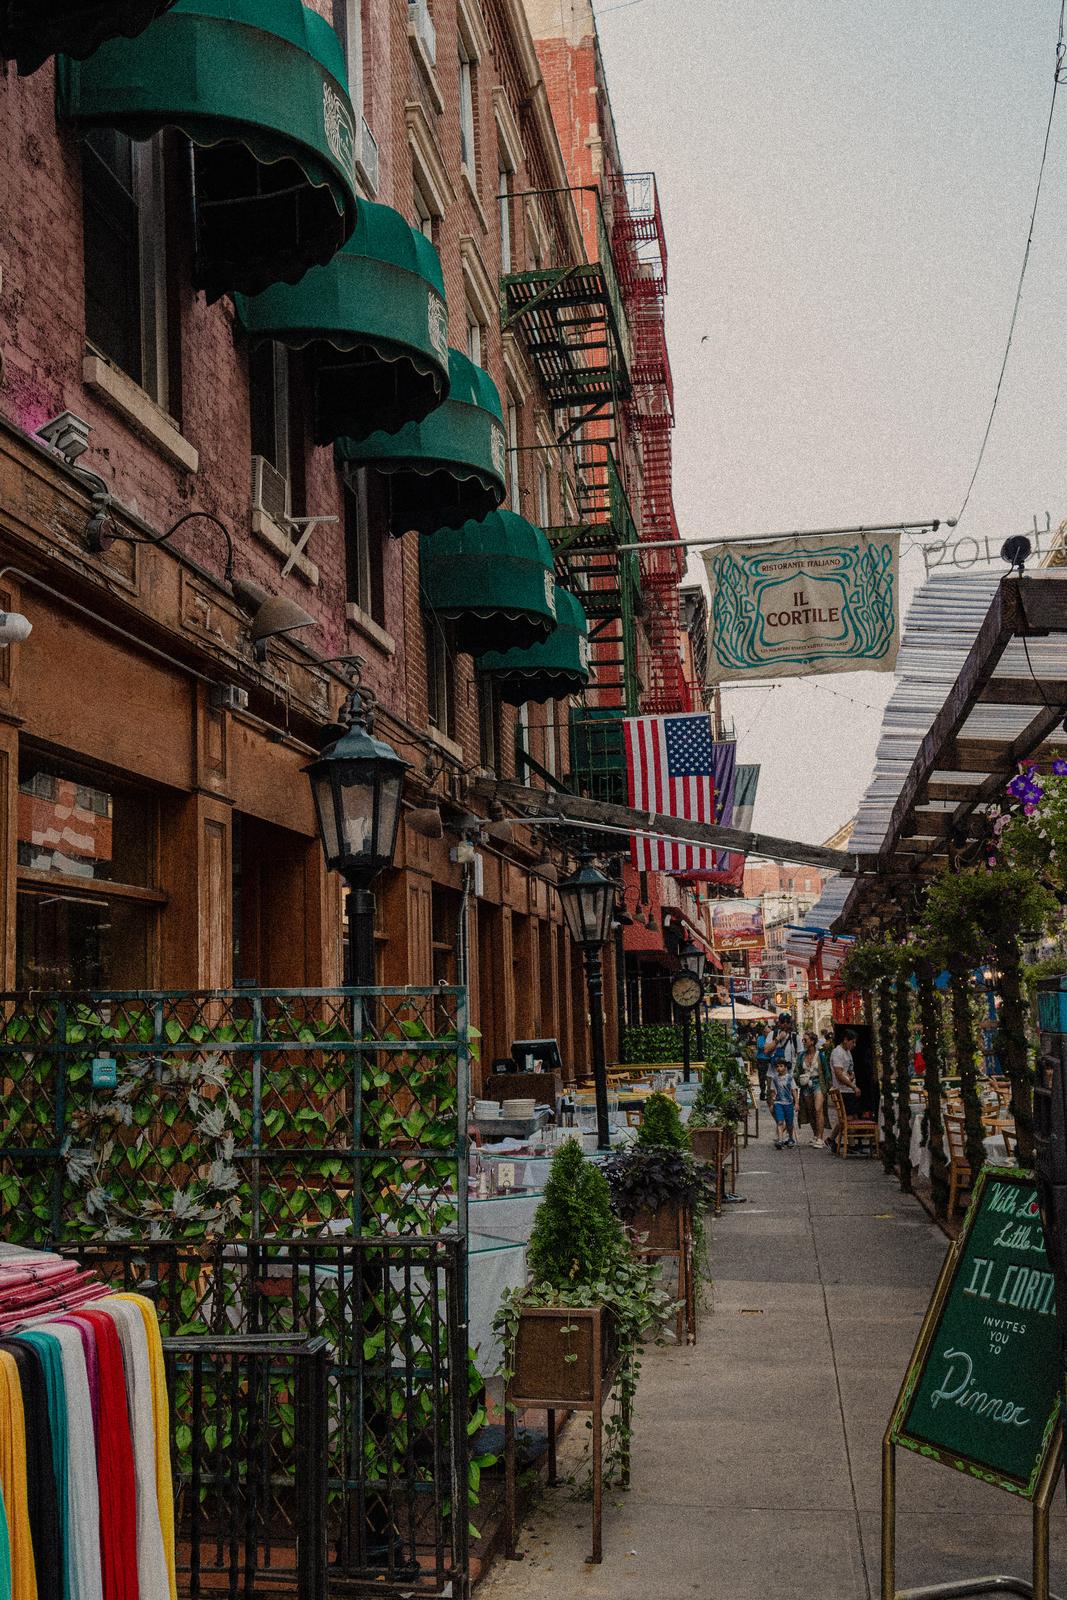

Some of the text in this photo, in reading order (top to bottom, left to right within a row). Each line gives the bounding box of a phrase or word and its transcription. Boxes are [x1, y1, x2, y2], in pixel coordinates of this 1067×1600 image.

[761, 559, 841, 572] RISTORANTE ITALIANO
[793, 591, 809, 607] IL
[766, 608, 840, 627] CORTILE
[987, 1182, 1020, 1214] With
[993, 1221, 1032, 1250] Little
[963, 1257, 1056, 1316] IL CORTI
[983, 1316, 1027, 1334] INVITES
[990, 1331, 1010, 1345] YOU
[989, 1344, 1002, 1355] TO
[930, 1347, 1031, 1425] Dinner
